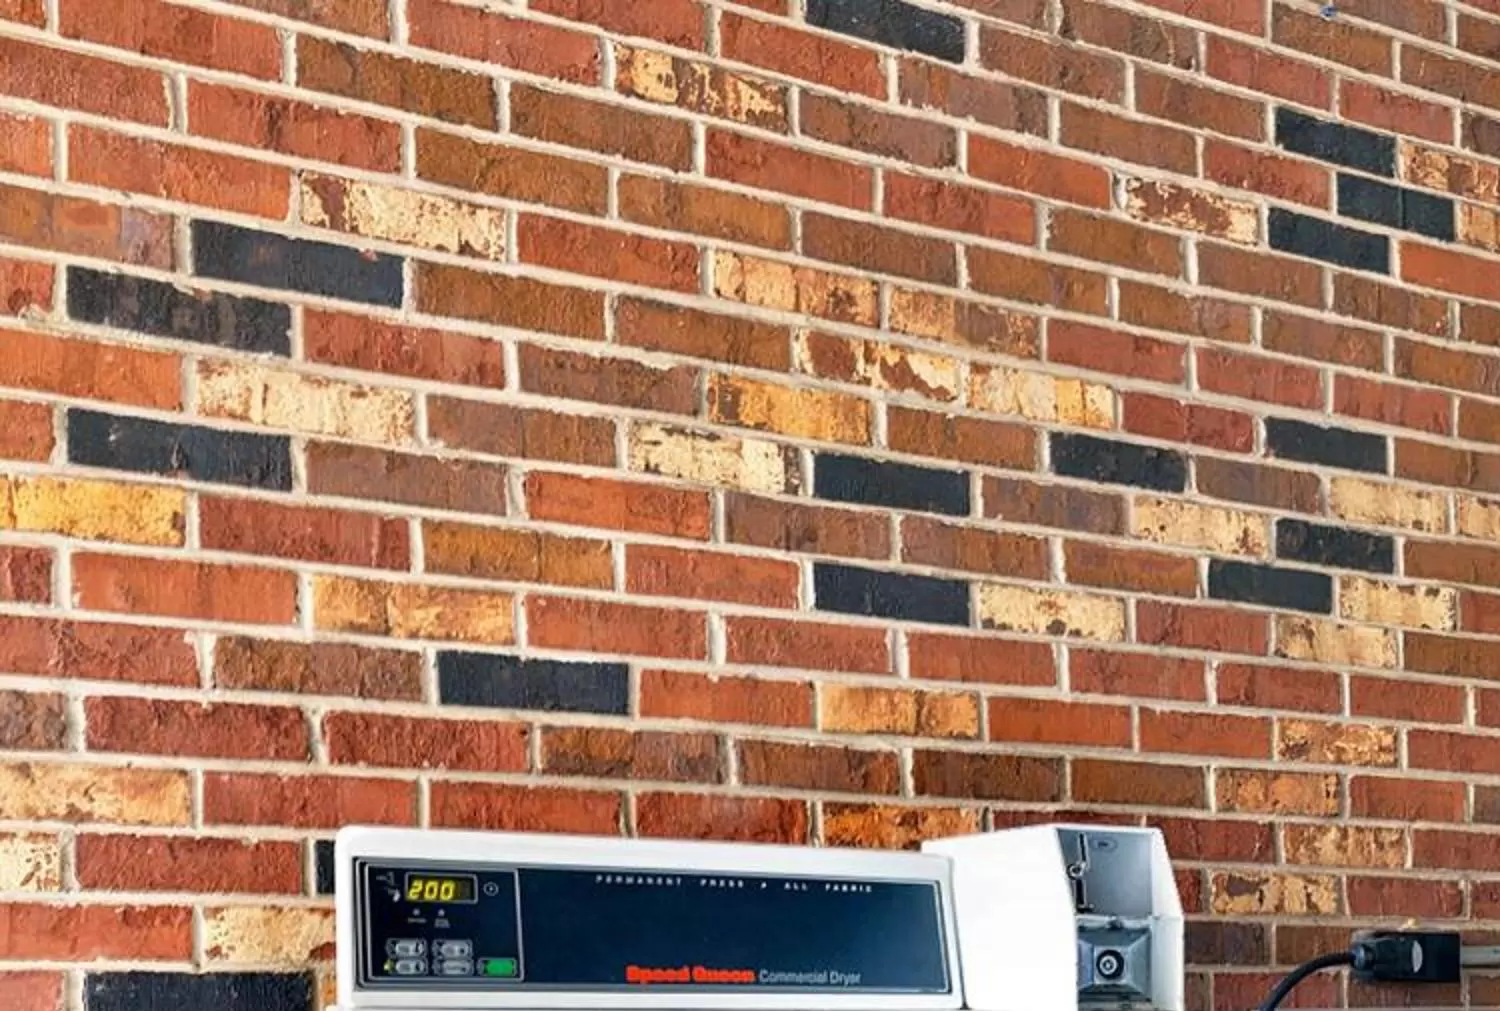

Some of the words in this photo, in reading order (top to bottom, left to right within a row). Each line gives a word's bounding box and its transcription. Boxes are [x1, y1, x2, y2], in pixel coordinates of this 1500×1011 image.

[407, 880, 455, 901] 200
[626, 964, 690, 984] Speed
[692, 966, 756, 983] Queen
[759, 969, 827, 983] Commercial
[829, 971, 861, 986] Dryer
